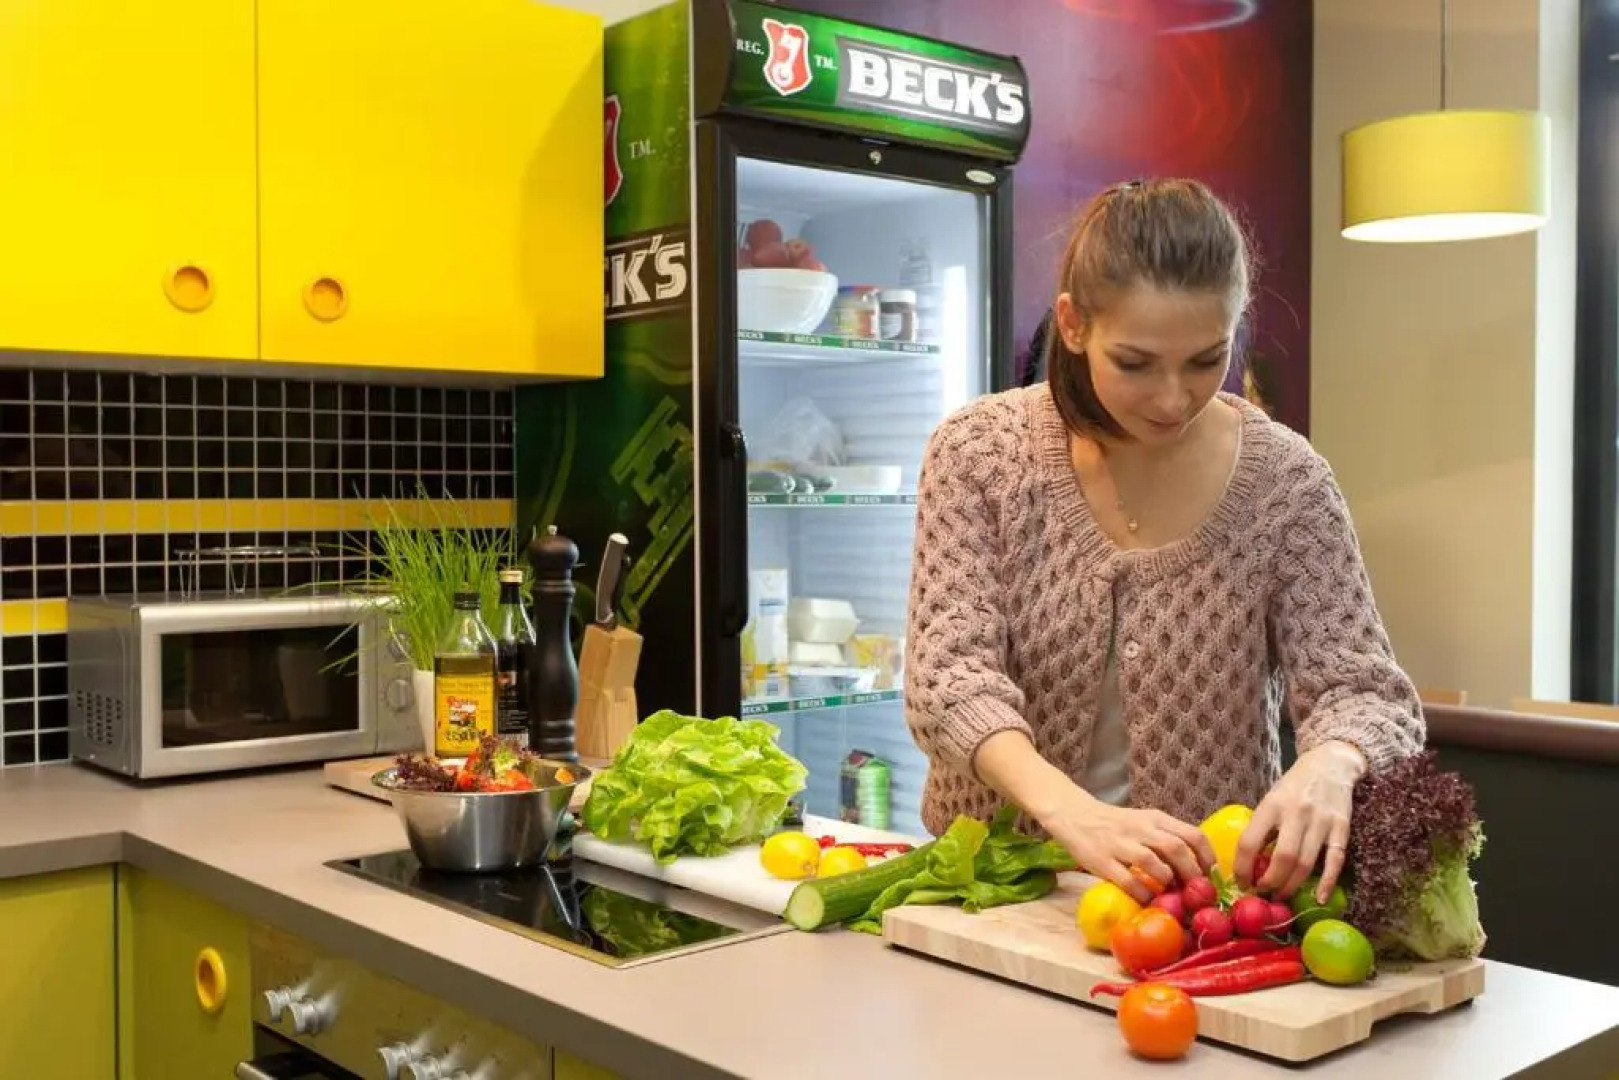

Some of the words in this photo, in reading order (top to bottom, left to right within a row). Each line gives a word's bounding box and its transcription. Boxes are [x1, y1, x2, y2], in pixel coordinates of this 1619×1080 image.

[736, 39, 764, 56] REG.
[814, 54, 837, 70] TM.
[847, 48, 1025, 124] BECK'S
[604, 234, 687, 308] K'S
